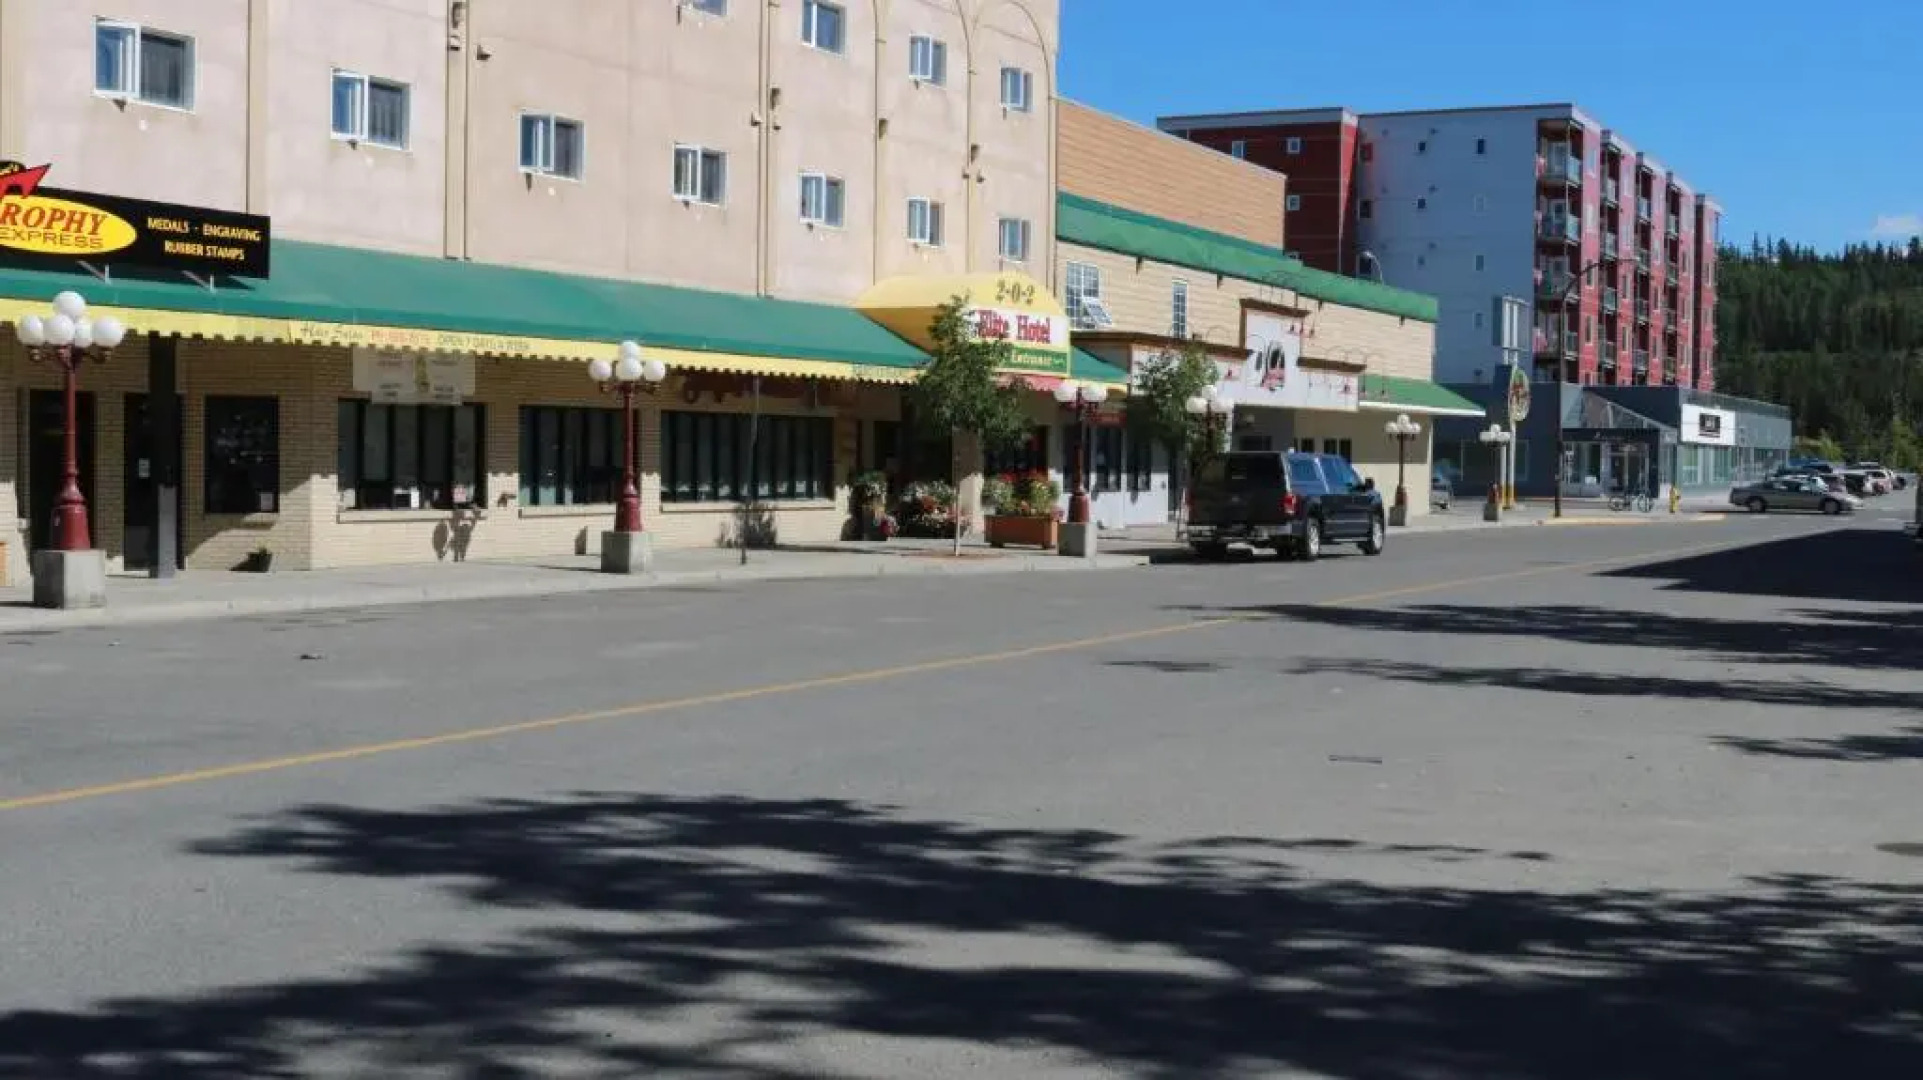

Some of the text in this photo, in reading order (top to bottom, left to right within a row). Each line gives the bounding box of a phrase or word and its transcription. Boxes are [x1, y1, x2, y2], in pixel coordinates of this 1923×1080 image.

[0, 227, 104, 248] EXPRESS
[147, 216, 261, 241] MEDALS ENGRAVING
[165, 240, 244, 260] RUBBER STAMPS
[1016, 315, 1050, 344] Hotel
